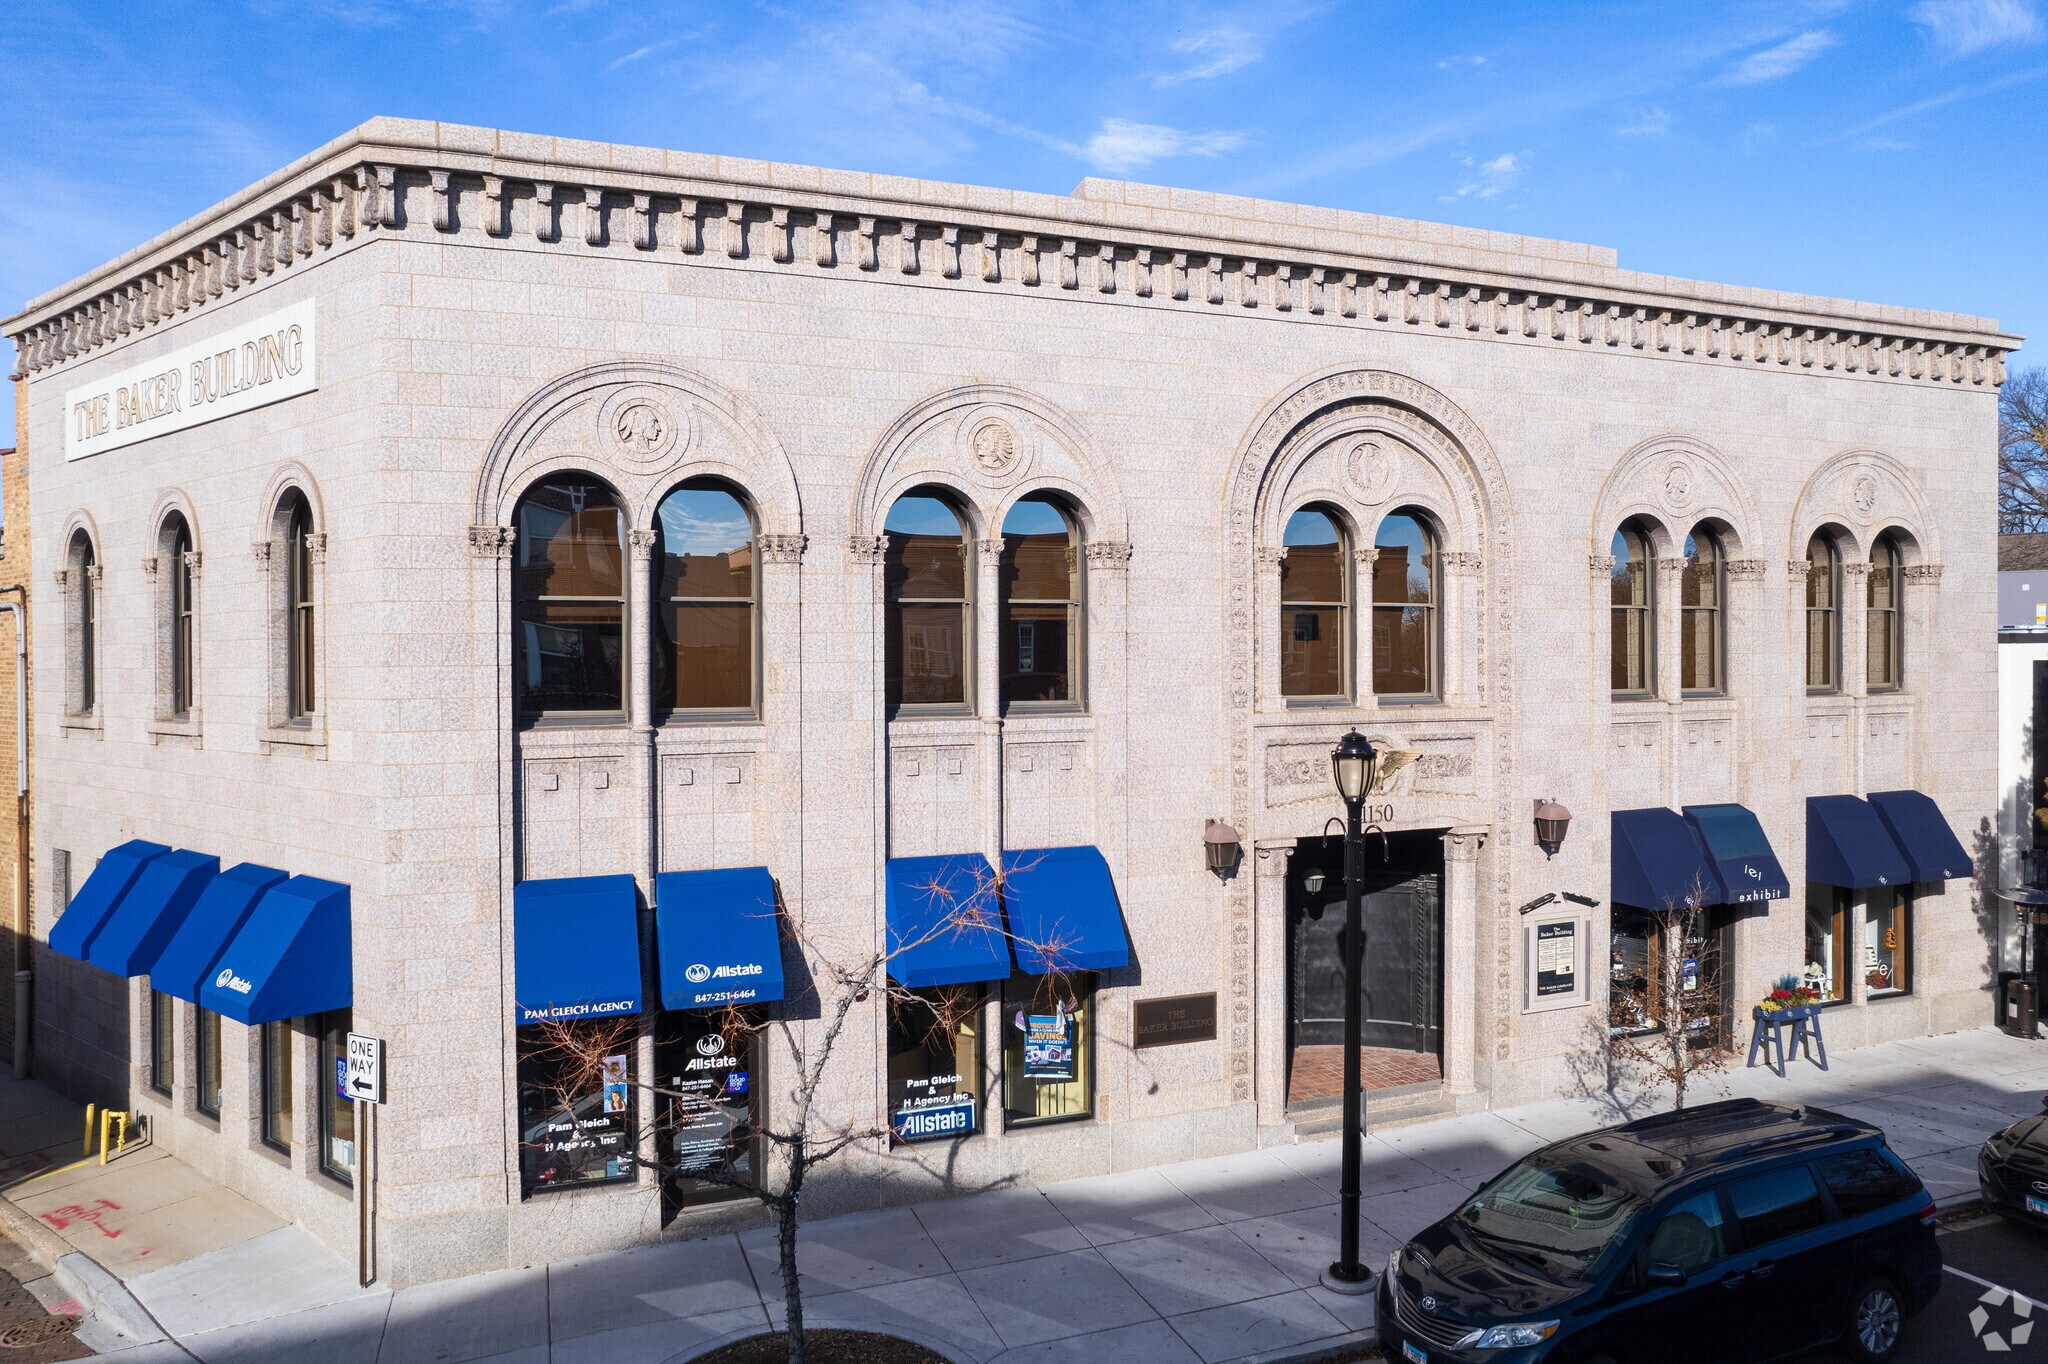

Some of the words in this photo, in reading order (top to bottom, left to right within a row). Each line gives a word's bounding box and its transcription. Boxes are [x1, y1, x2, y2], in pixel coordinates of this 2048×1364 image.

[74, 392, 110, 442] THE
[116, 368, 182, 429] BAKER
[189, 324, 303, 407] BUILDING
[1362, 804, 1394, 823] 1150
[1739, 889, 1780, 901] exhibit
[712, 963, 763, 978] Allstate
[226, 976, 252, 994] Allstate
[695, 989, 756, 1003] 847-251-6464
[524, 1009, 548, 1019] PAM
[551, 1005, 589, 1016] GLEICH
[591, 1000, 634, 1012] AGENCY
[1168, 1010, 1186, 1019] THE
[1138, 1022, 1168, 1034] BAKER
[1171, 1018, 1214, 1031] BUILDING
[351, 1040, 373, 1057] ONE
[350, 1057, 373, 1075] WAY
[684, 1056, 737, 1071] Allstate
[907, 1079, 928, 1088] Pam
[931, 1073, 963, 1085] Gleich
[928, 1086, 936, 1095] &
[904, 1099, 911, 1108] H
[914, 1095, 951, 1107] Agency
[953, 1092, 969, 1101] Inc
[548, 1123, 572, 1132] Pam
[900, 1110, 966, 1136] Allstate
[600, 1136, 617, 1145] Inc
